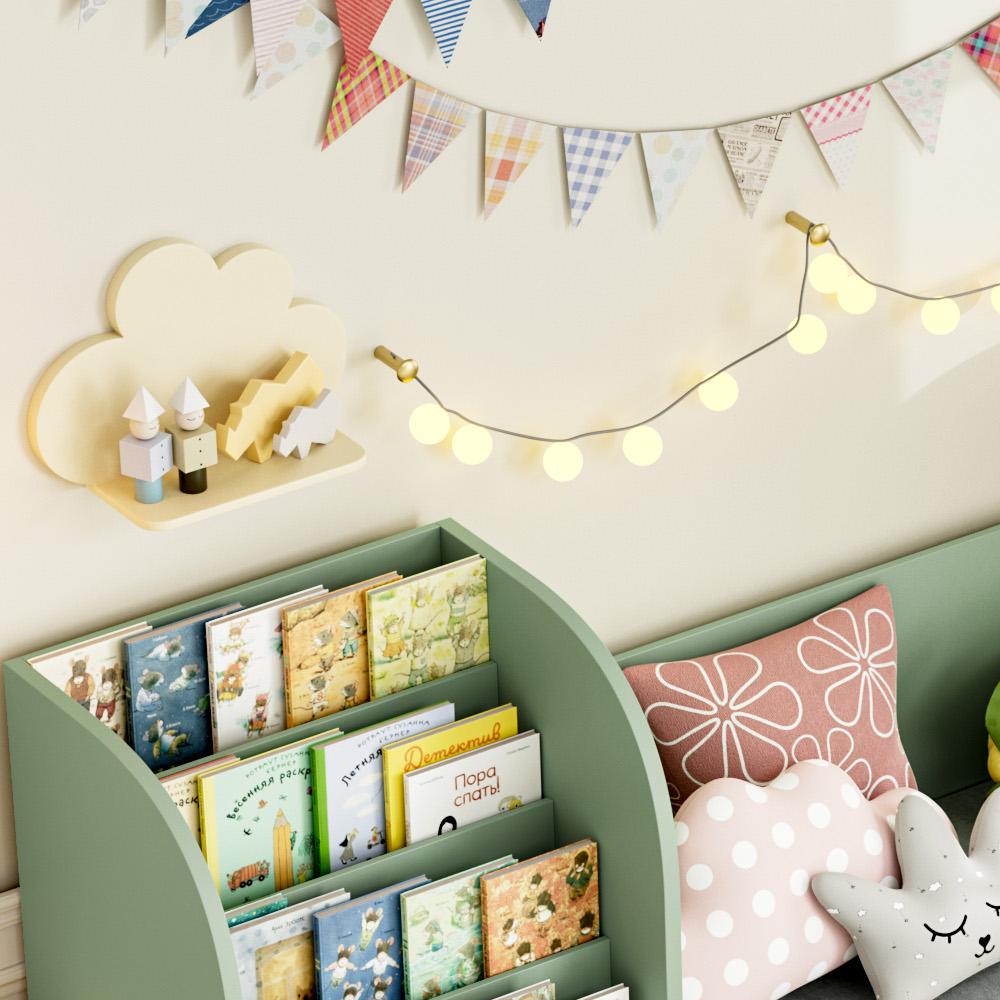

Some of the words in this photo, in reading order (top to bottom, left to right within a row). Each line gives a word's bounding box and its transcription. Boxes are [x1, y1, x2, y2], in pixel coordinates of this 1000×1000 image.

[403, 721, 502, 773] Детектив
[341, 747, 383, 788] Летняя
[454, 766, 497, 791] Пора
[453, 775, 501, 808] спать!
